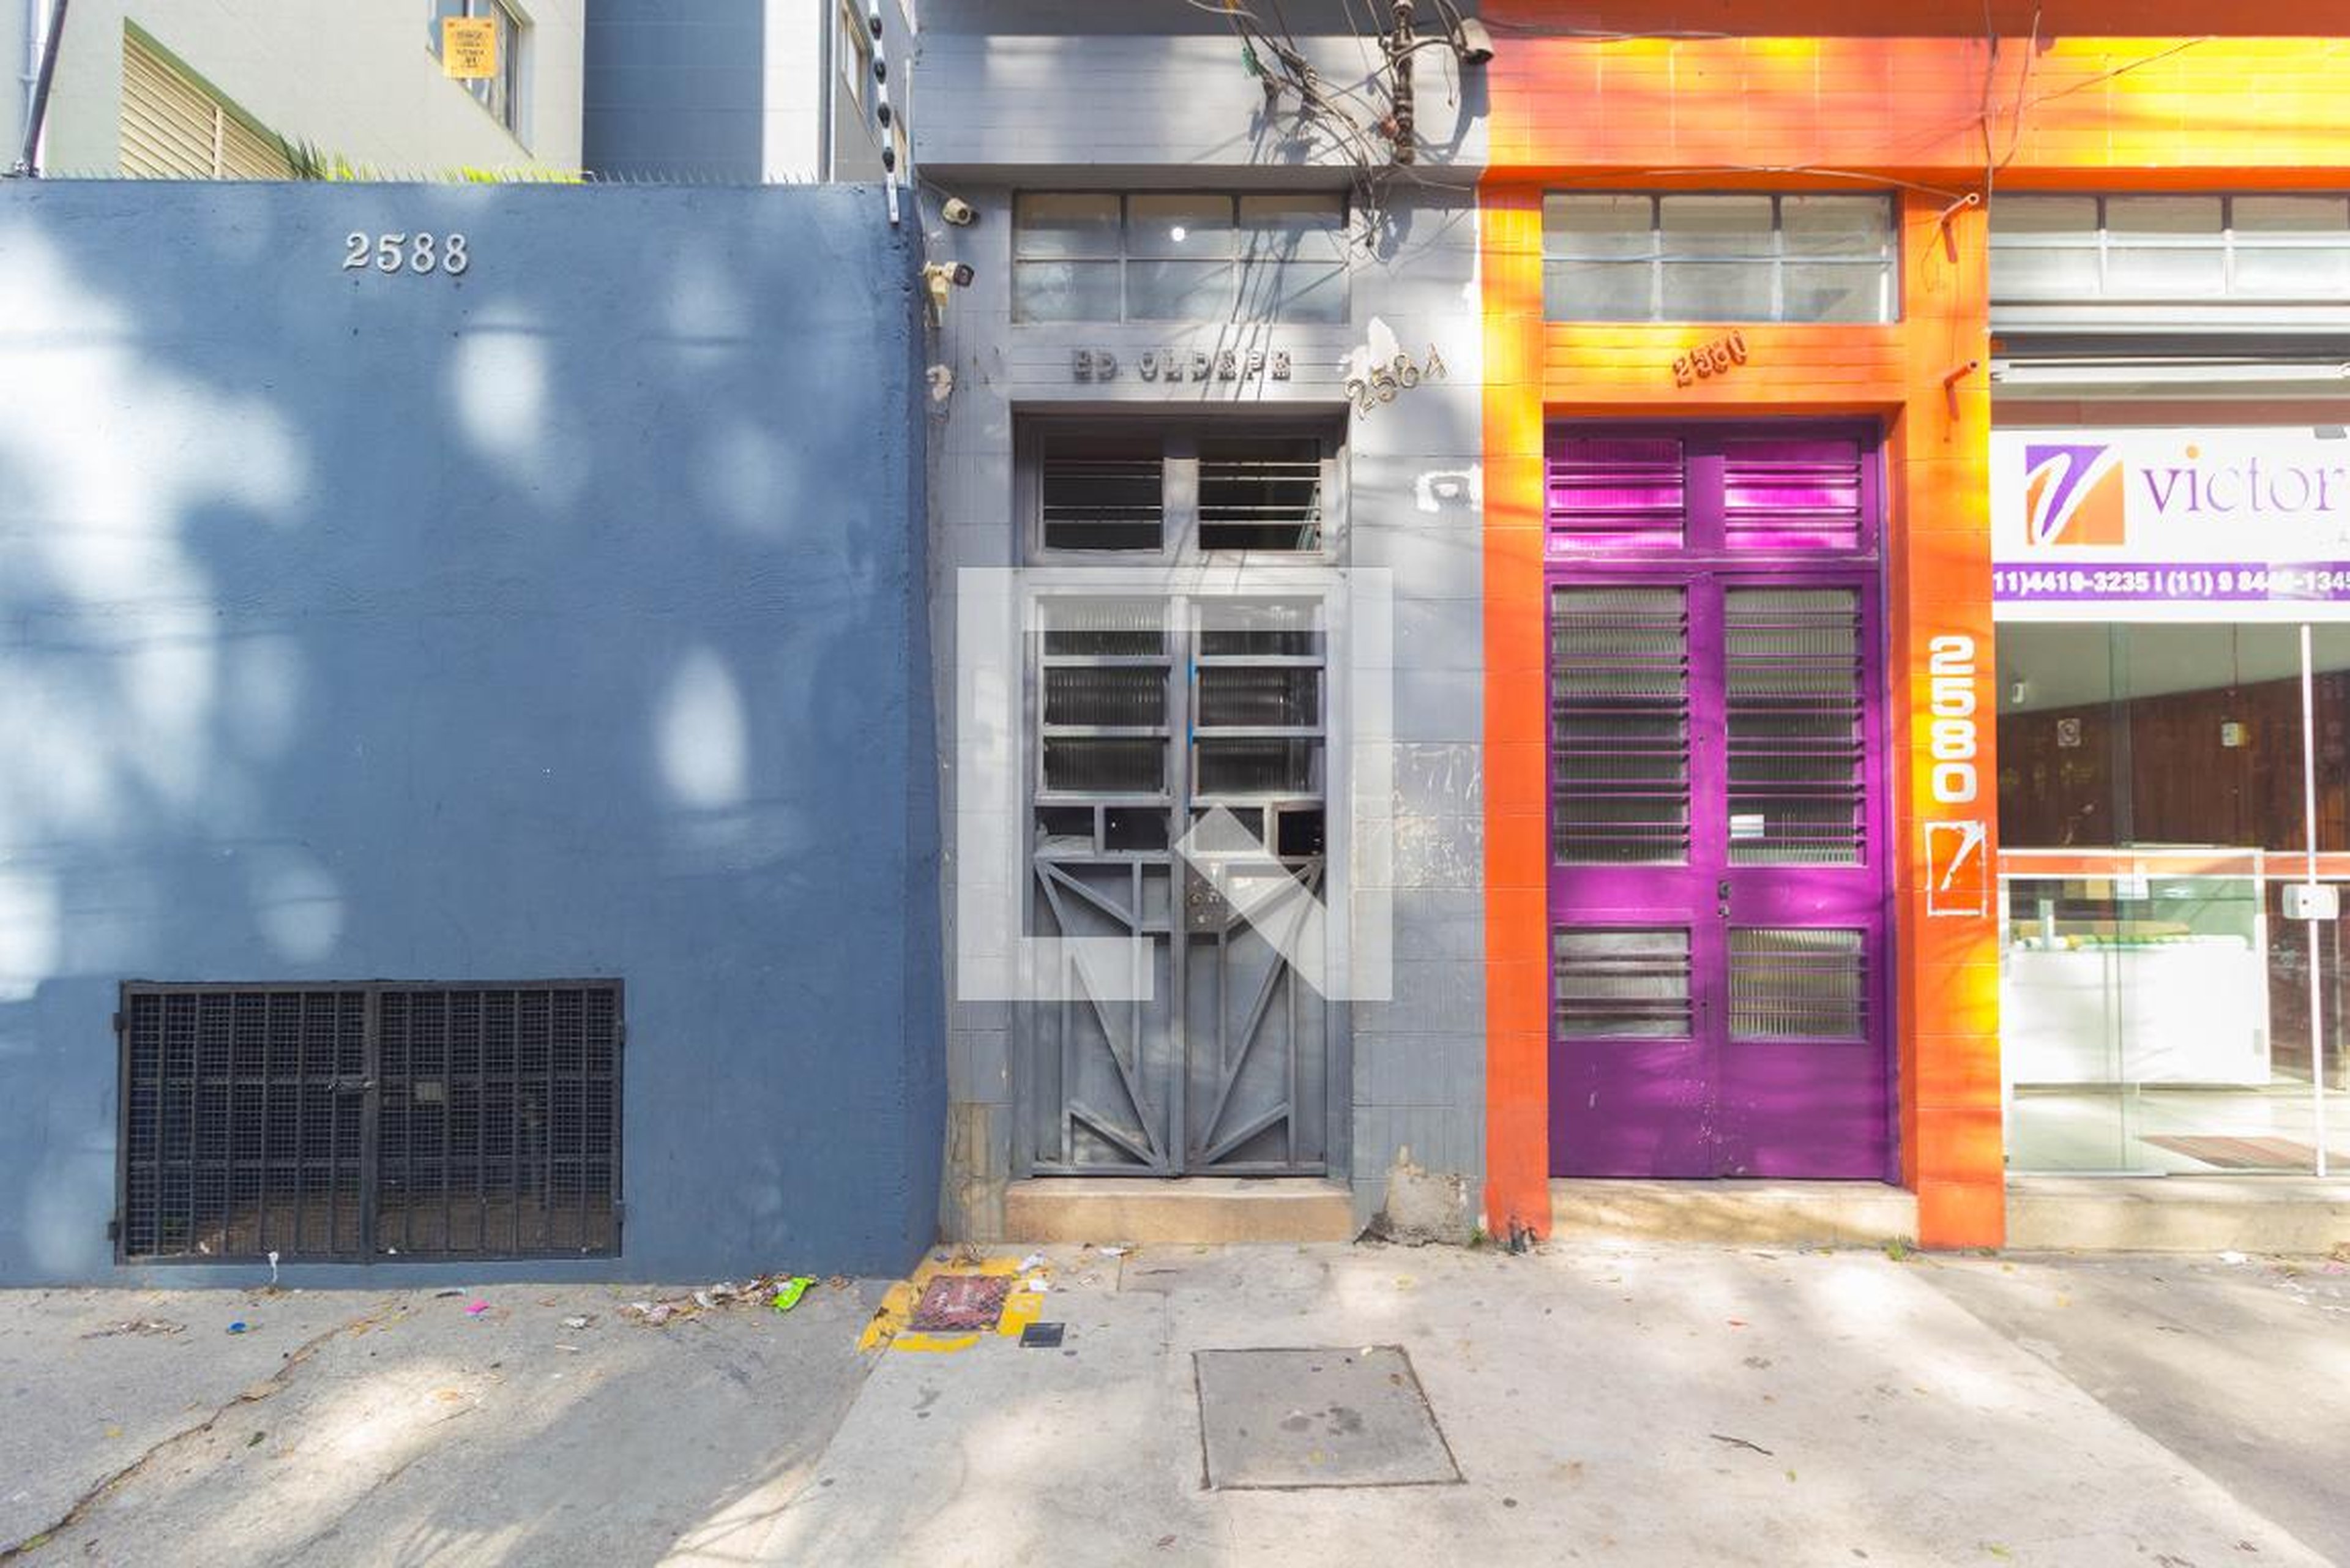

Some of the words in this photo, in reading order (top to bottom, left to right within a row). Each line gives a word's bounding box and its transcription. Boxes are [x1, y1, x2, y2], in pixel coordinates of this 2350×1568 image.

[343, 232, 468, 274] 2588
[2167, 570, 2213, 596] (11)
[1929, 635, 1977, 804] 2580
